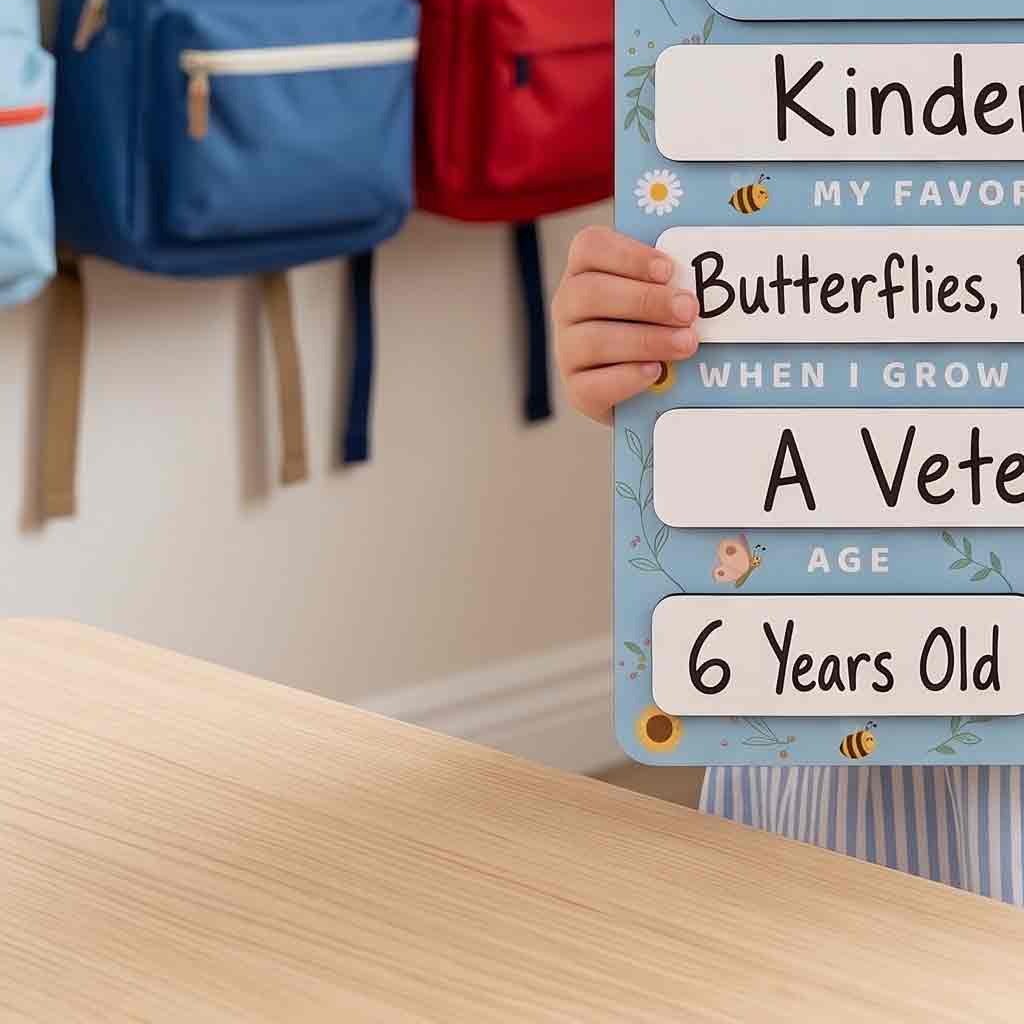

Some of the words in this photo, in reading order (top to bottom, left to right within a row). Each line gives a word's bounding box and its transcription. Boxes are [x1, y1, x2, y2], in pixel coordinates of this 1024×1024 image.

[813, 180, 872, 208] MY
[691, 250, 1000, 322] Butterflies,
[700, 362, 826, 390] WHEN
[849, 362, 860, 389] I
[882, 362, 1011, 390] GROW
[764, 429, 817, 514] A
[807, 546, 891, 574] AGE
[688, 620, 732, 696] 6
[763, 620, 895, 696] Years
[919, 625, 1002, 693] Old
